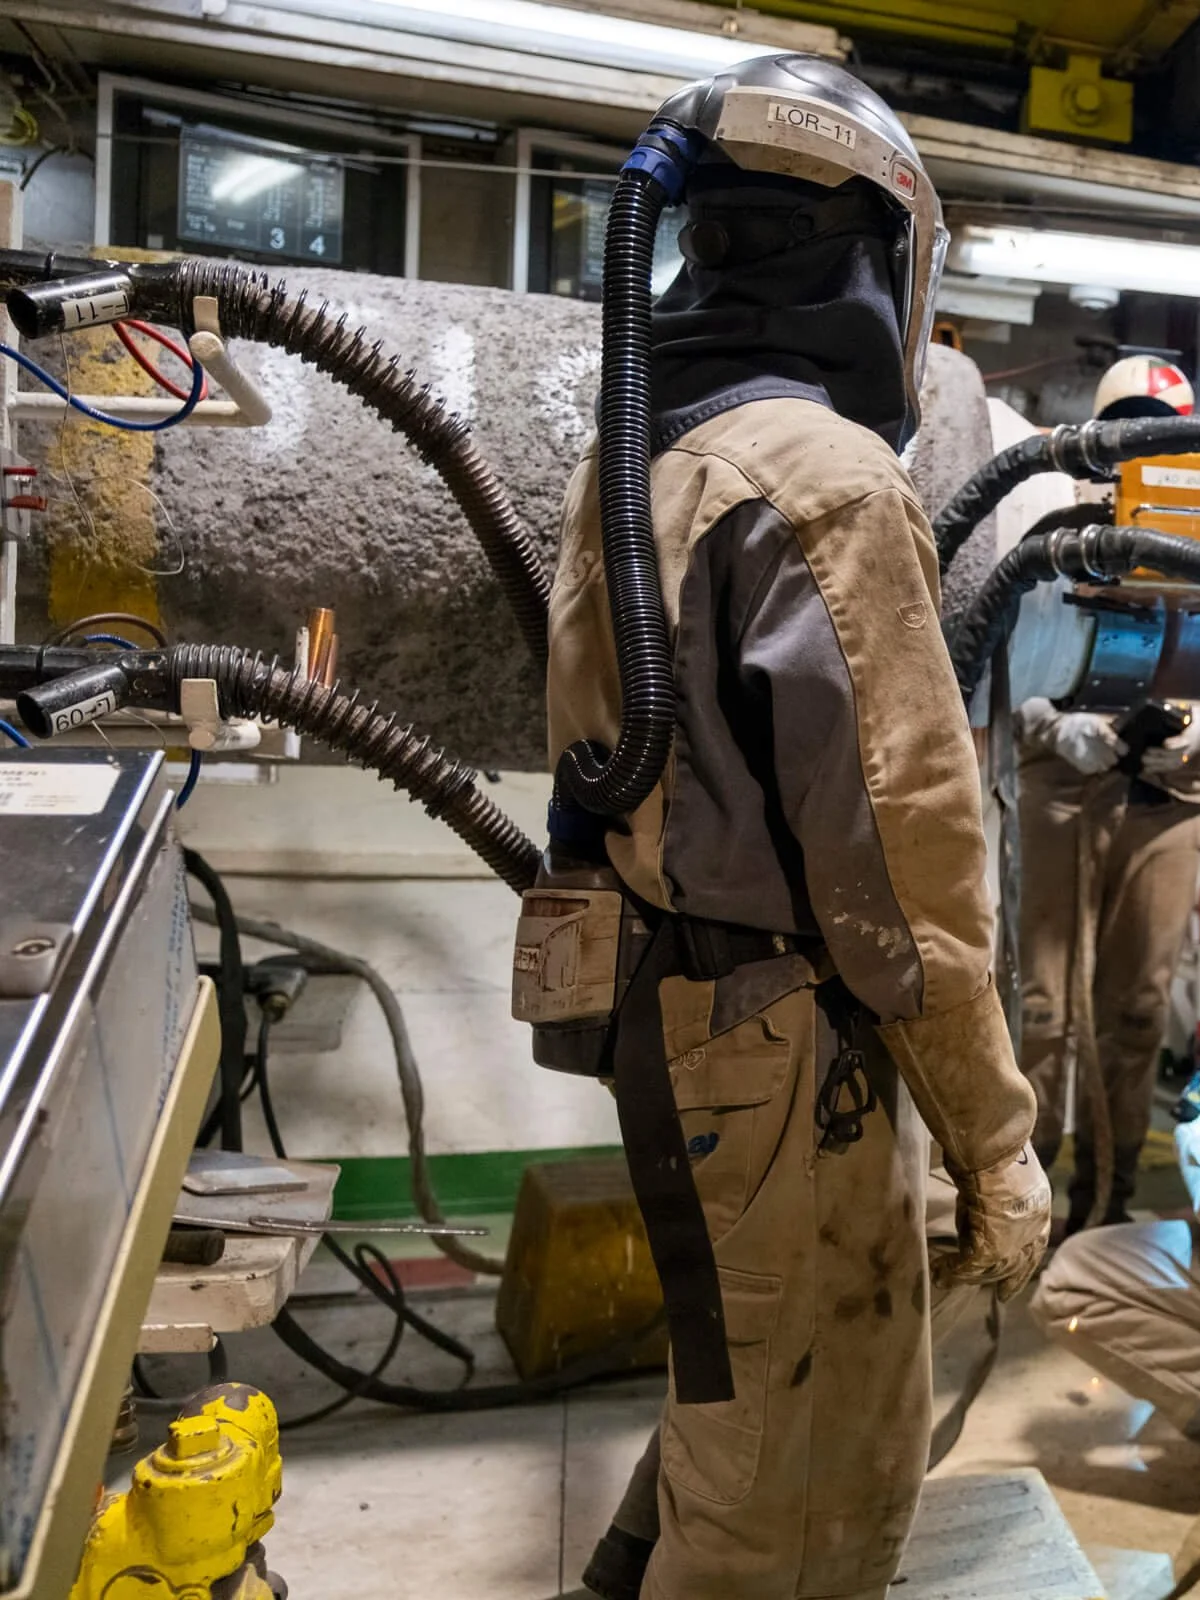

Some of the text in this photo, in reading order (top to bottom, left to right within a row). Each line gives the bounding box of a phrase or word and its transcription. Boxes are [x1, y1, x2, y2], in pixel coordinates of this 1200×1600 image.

[775, 105, 851, 145] LOR-11
[896, 172, 913, 190] 3M
[270, 227, 325, 256] 3 4
